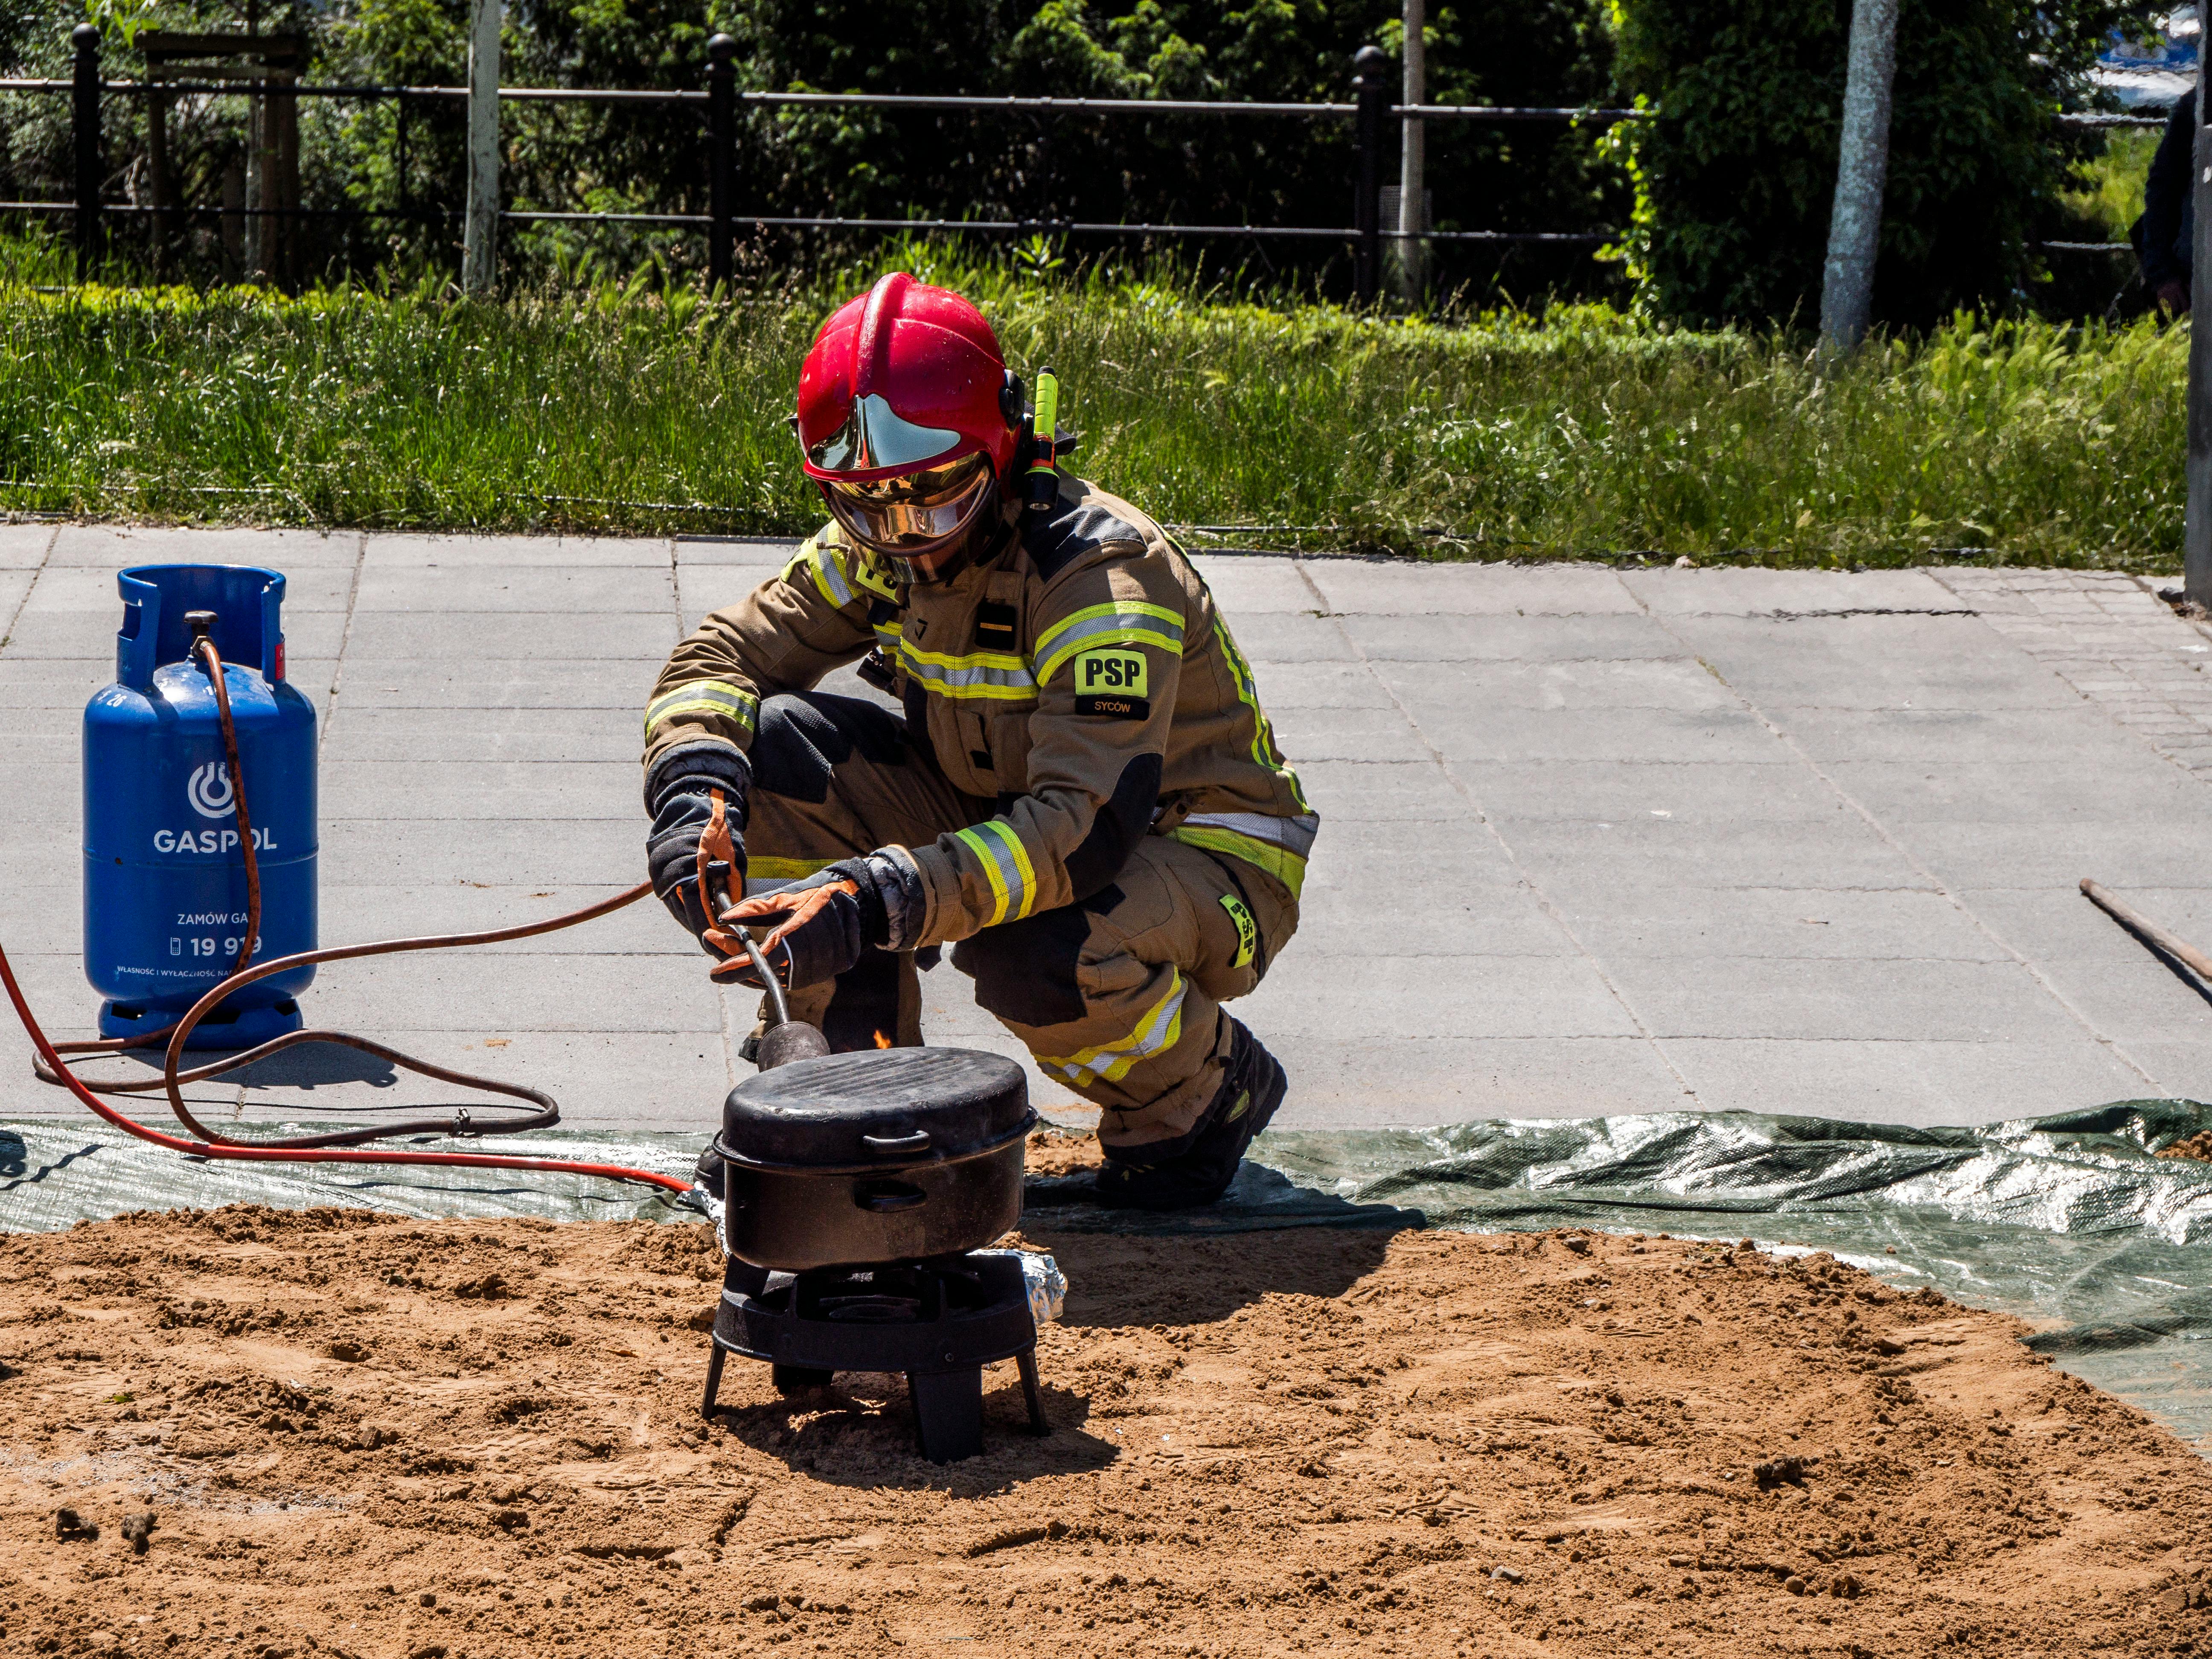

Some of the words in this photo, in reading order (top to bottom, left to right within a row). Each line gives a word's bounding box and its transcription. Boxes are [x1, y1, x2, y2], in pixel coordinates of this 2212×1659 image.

[1086, 658, 1140, 687] PSP
[1094, 701, 1130, 713] SYCÓW
[177, 912, 228, 925] ZAMÓW
[231, 912, 248, 924] GA
[1230, 902, 1254, 955] PSP
[190, 938, 215, 956] 19
